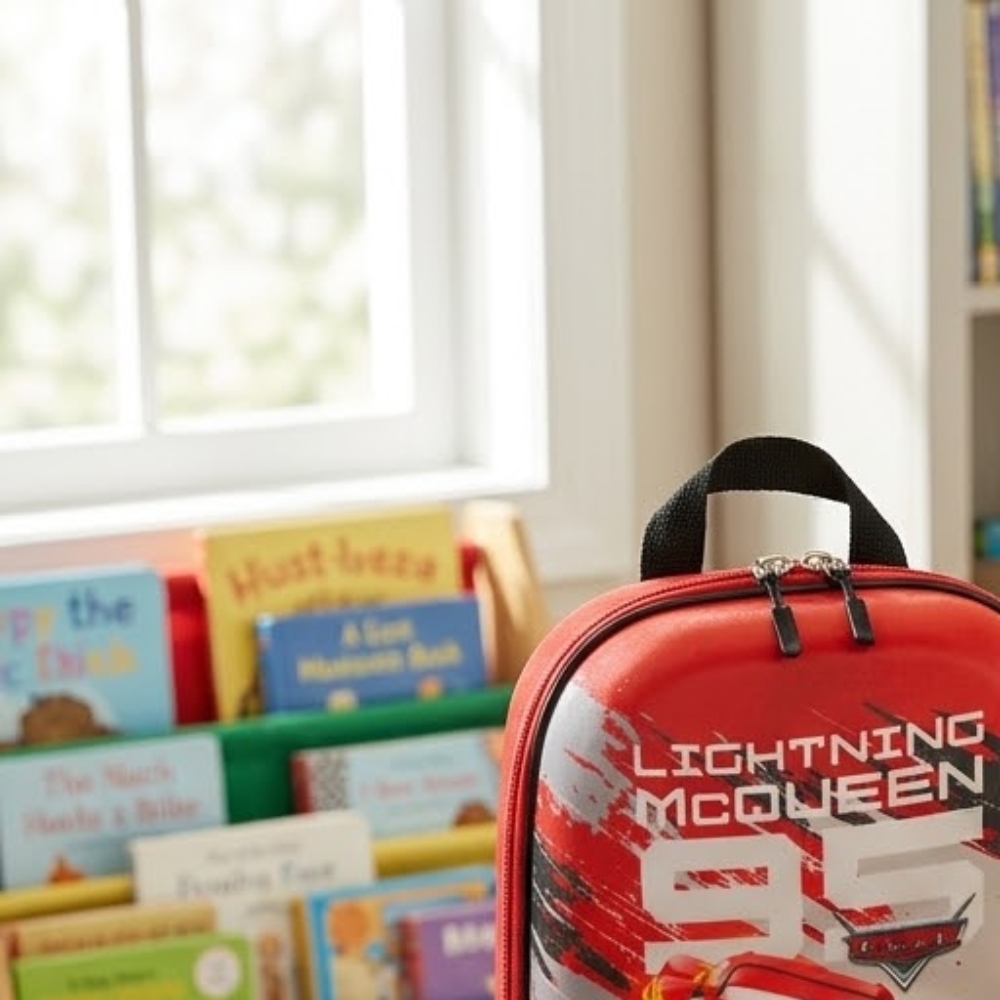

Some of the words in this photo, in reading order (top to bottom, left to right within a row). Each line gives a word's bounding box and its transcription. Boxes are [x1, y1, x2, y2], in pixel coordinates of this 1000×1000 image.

[633, 710, 985, 778] LIGHTNING
[635, 753, 984, 828] MCQUEEN
[640, 805, 985, 976] 95
